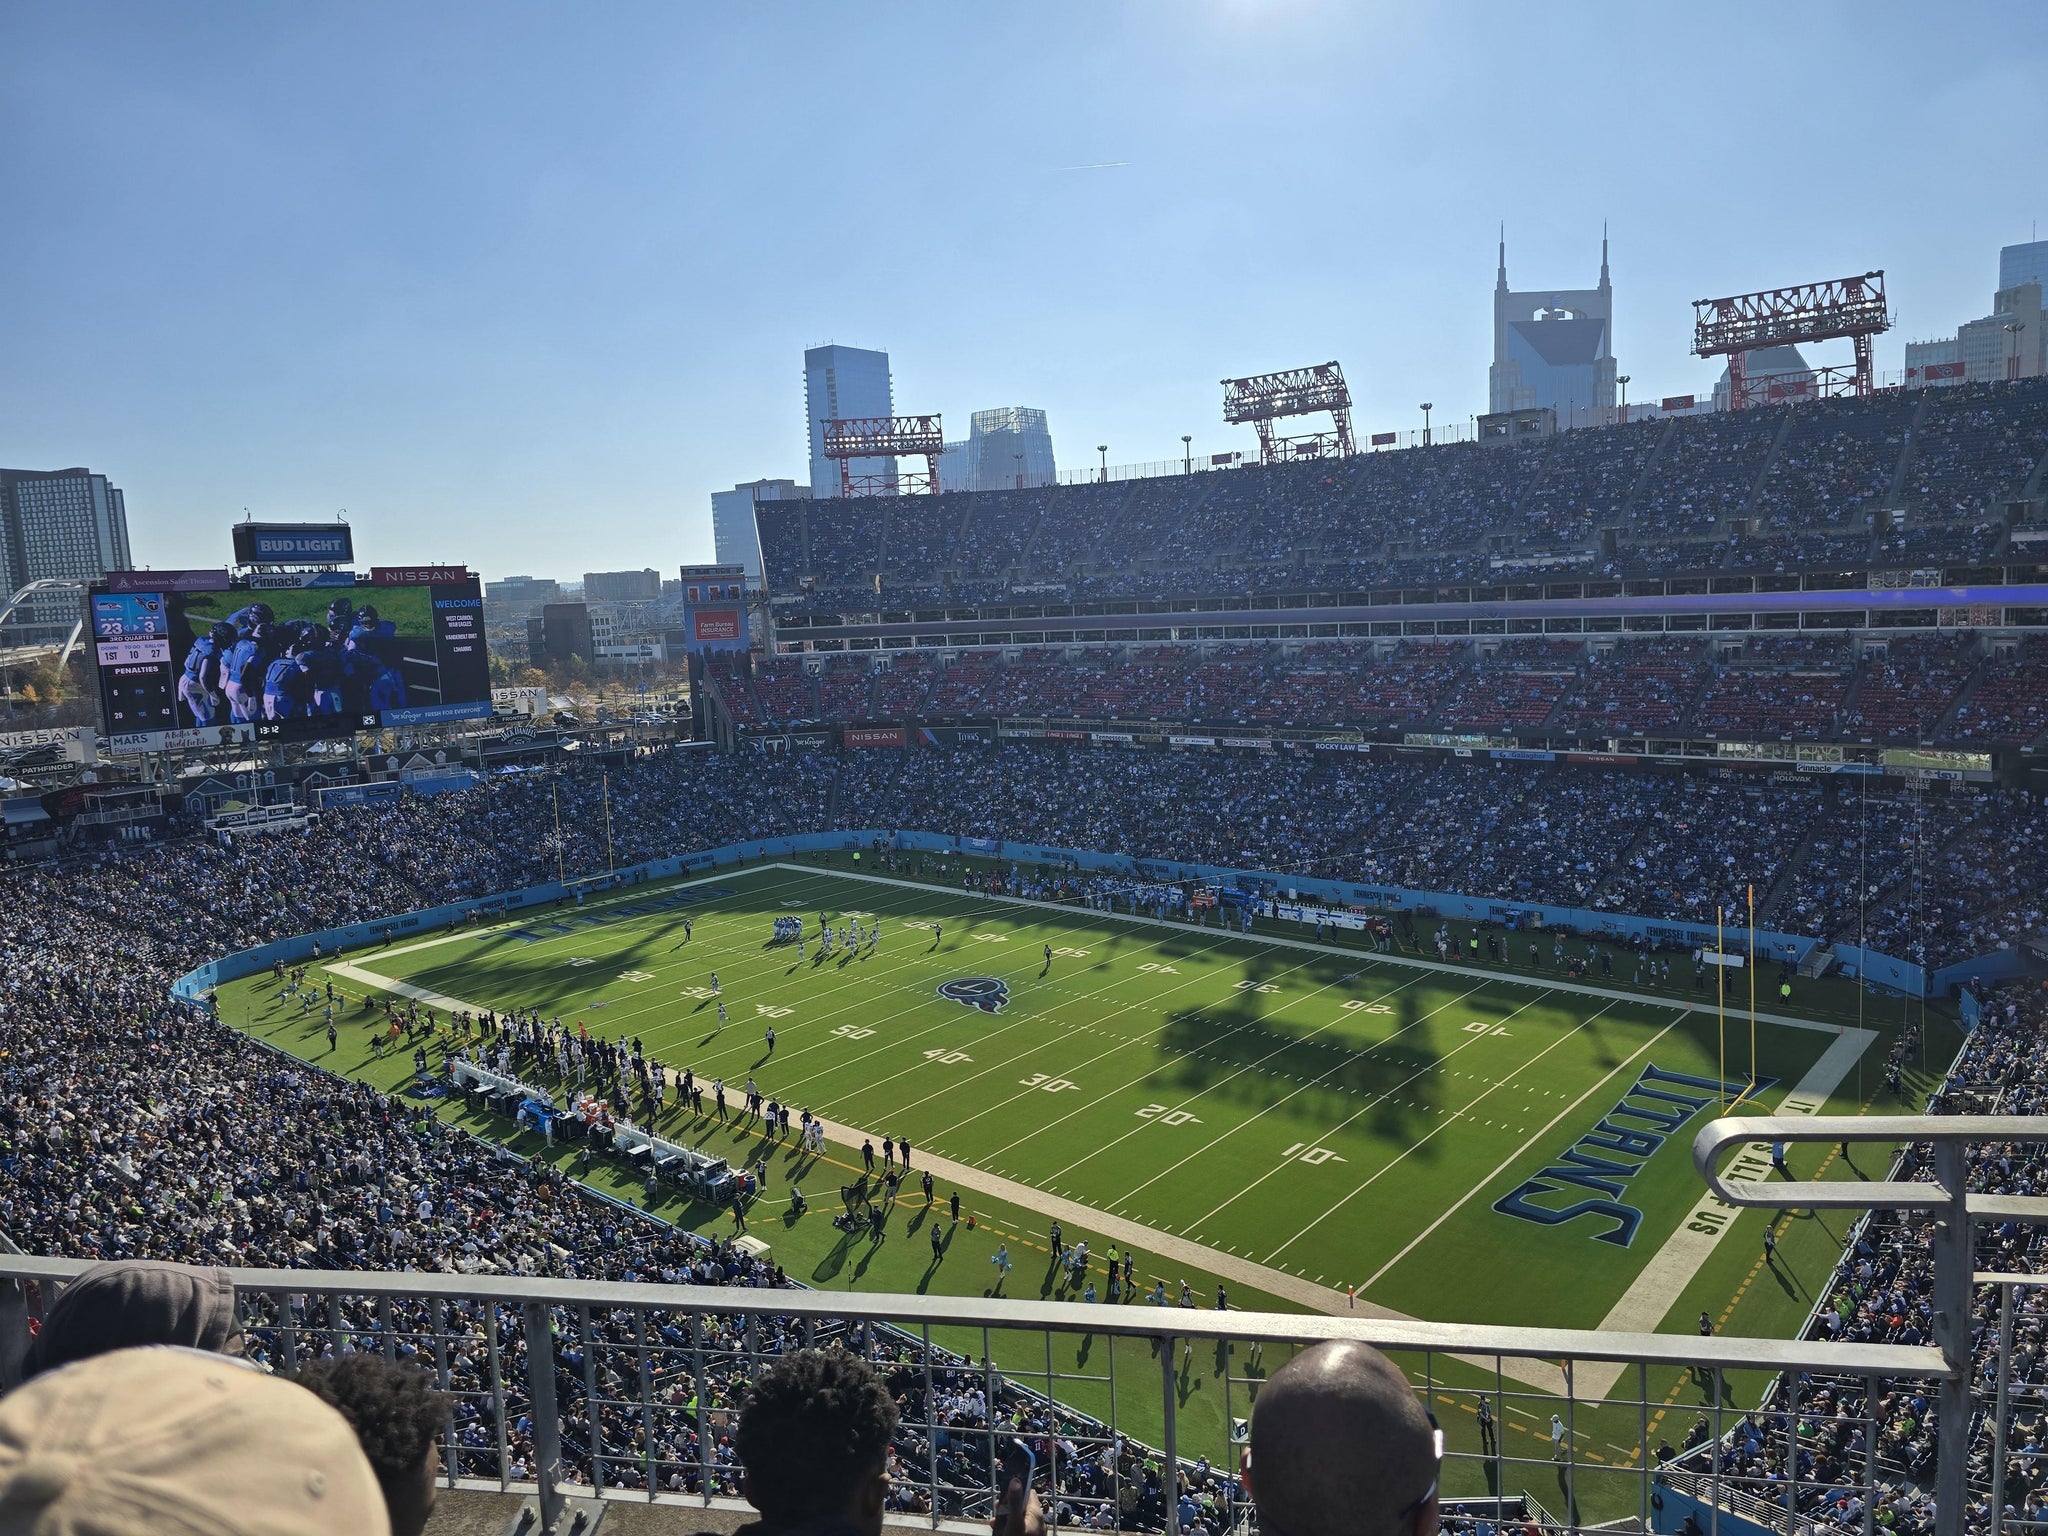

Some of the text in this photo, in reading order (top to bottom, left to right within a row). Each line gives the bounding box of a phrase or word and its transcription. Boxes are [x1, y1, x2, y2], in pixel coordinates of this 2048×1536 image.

[260, 538, 341, 552] BUD LIGHT
[133, 578, 169, 586] Ascension
[251, 575, 302, 588] Pinnacle
[385, 571, 456, 582] NISSAN
[434, 599, 481, 608] WELCOME
[101, 622, 123, 635] 23
[144, 621, 155, 633] 3
[105, 652, 118, 660] 1ST
[129, 650, 139, 659] 10
[151, 649, 161, 658] 27
[115, 666, 159, 675] PENALTIES
[491, 689, 537, 700] ISSAN
[401, 711, 422, 722] Kroger
[502, 714, 529, 722] FRONTIER
[113, 734, 148, 746] MARS
[851, 732, 898, 741] NISSAN
[804, 737, 826, 748] Kroger
[114, 746, 143, 754] Petcare
[1511, 751, 1546, 759] Gallagher
[22, 763, 74, 774] PATHFINDER
[1797, 764, 1832, 772] Pinnacle
[1773, 775, 1812, 783] HOLOVAK
[1645, 926, 1684, 940] TENNESSEE
[617, 971, 657, 982] 20
[755, 1004, 796, 1018] 40
[1340, 1000, 1391, 1014] 20
[829, 1024, 877, 1040] 50
[1462, 1022, 1506, 1036] 10
[922, 1048, 973, 1066] 40
[1018, 1073, 1075, 1093] 30
[1134, 1104, 1196, 1126] 20
[1281, 1143, 1338, 1165] 10
[1491, 1061, 1781, 1249] TITANS
[1725, 1155, 1769, 1182] ALL
[1687, 1211, 1729, 1237] US
